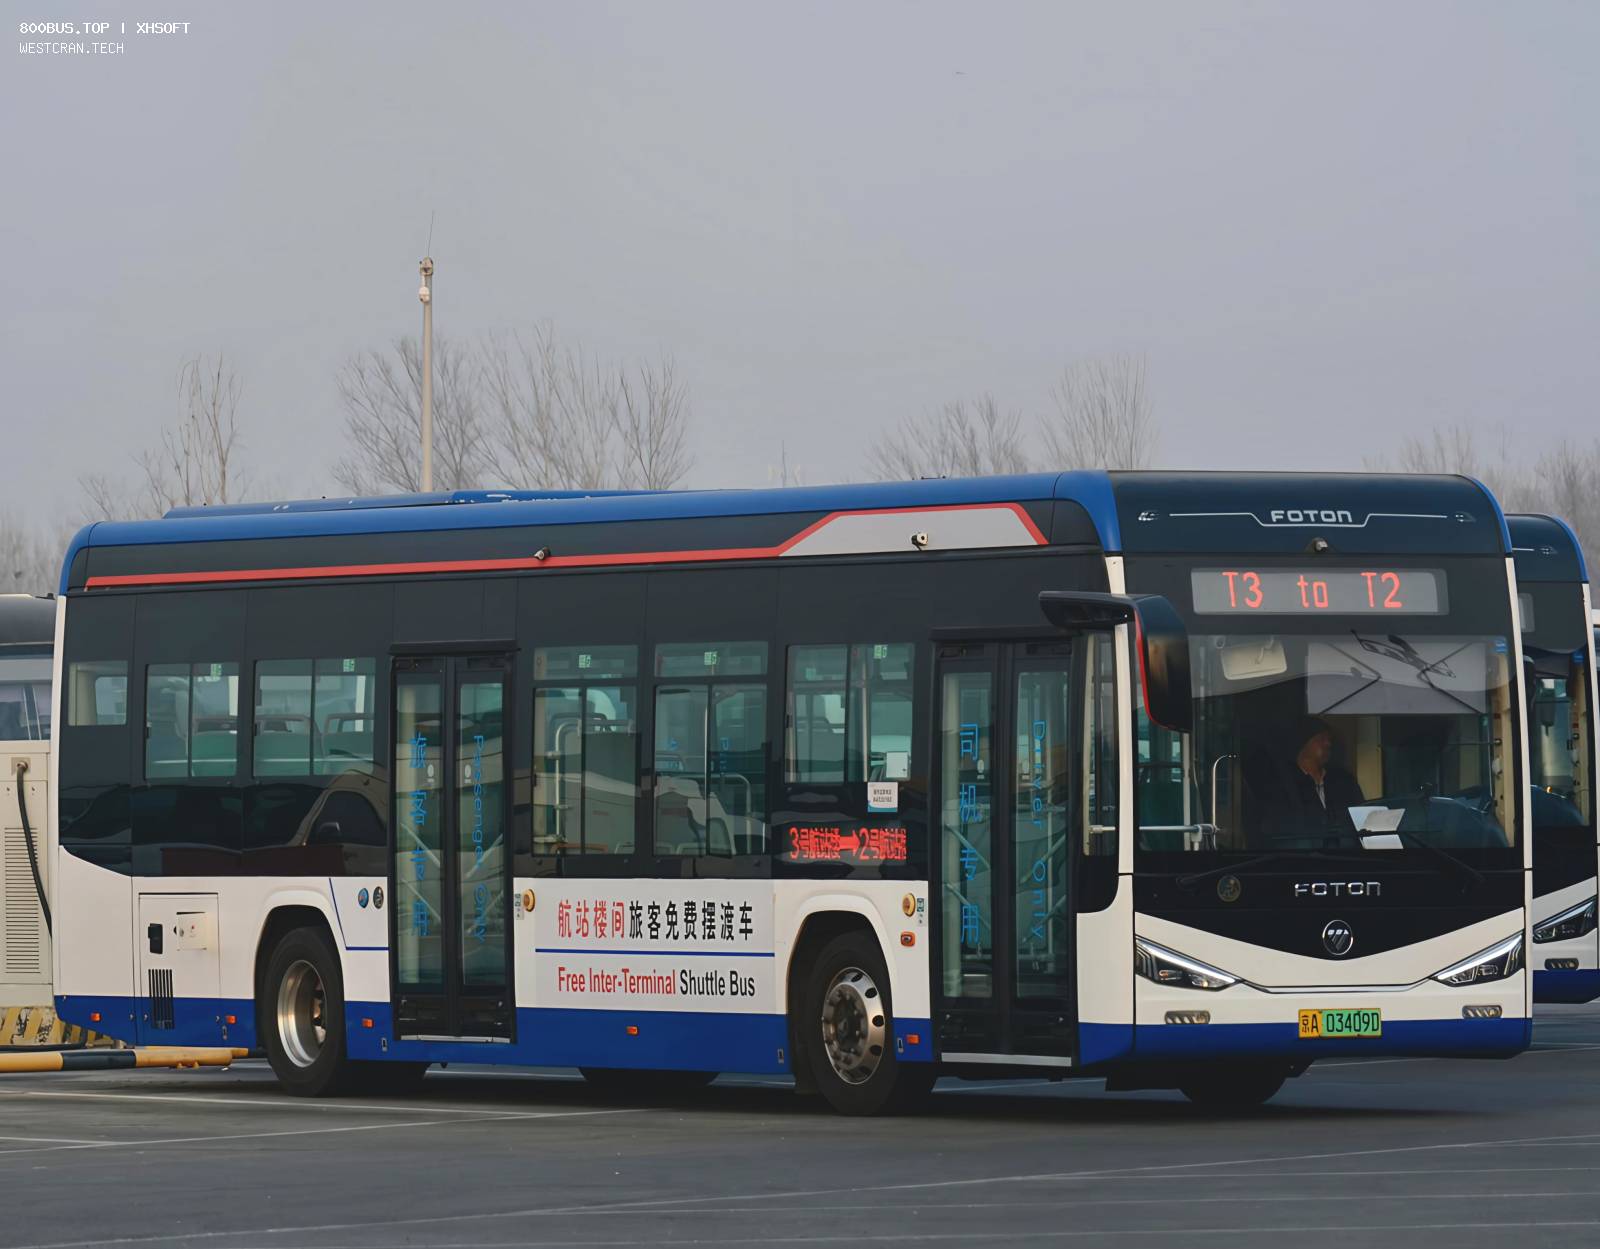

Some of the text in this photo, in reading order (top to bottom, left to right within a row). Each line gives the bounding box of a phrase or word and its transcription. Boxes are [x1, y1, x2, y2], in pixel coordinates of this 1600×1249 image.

[1270, 510, 1353, 523] FOTON
[1222, 571, 1403, 608] T3 to T2
[1294, 881, 1381, 897] FOTON
[558, 899, 754, 941] 航站楼间旅客免费摆渡车
[558, 966, 756, 997] Free Inter-Terminal Shuttle Bus
